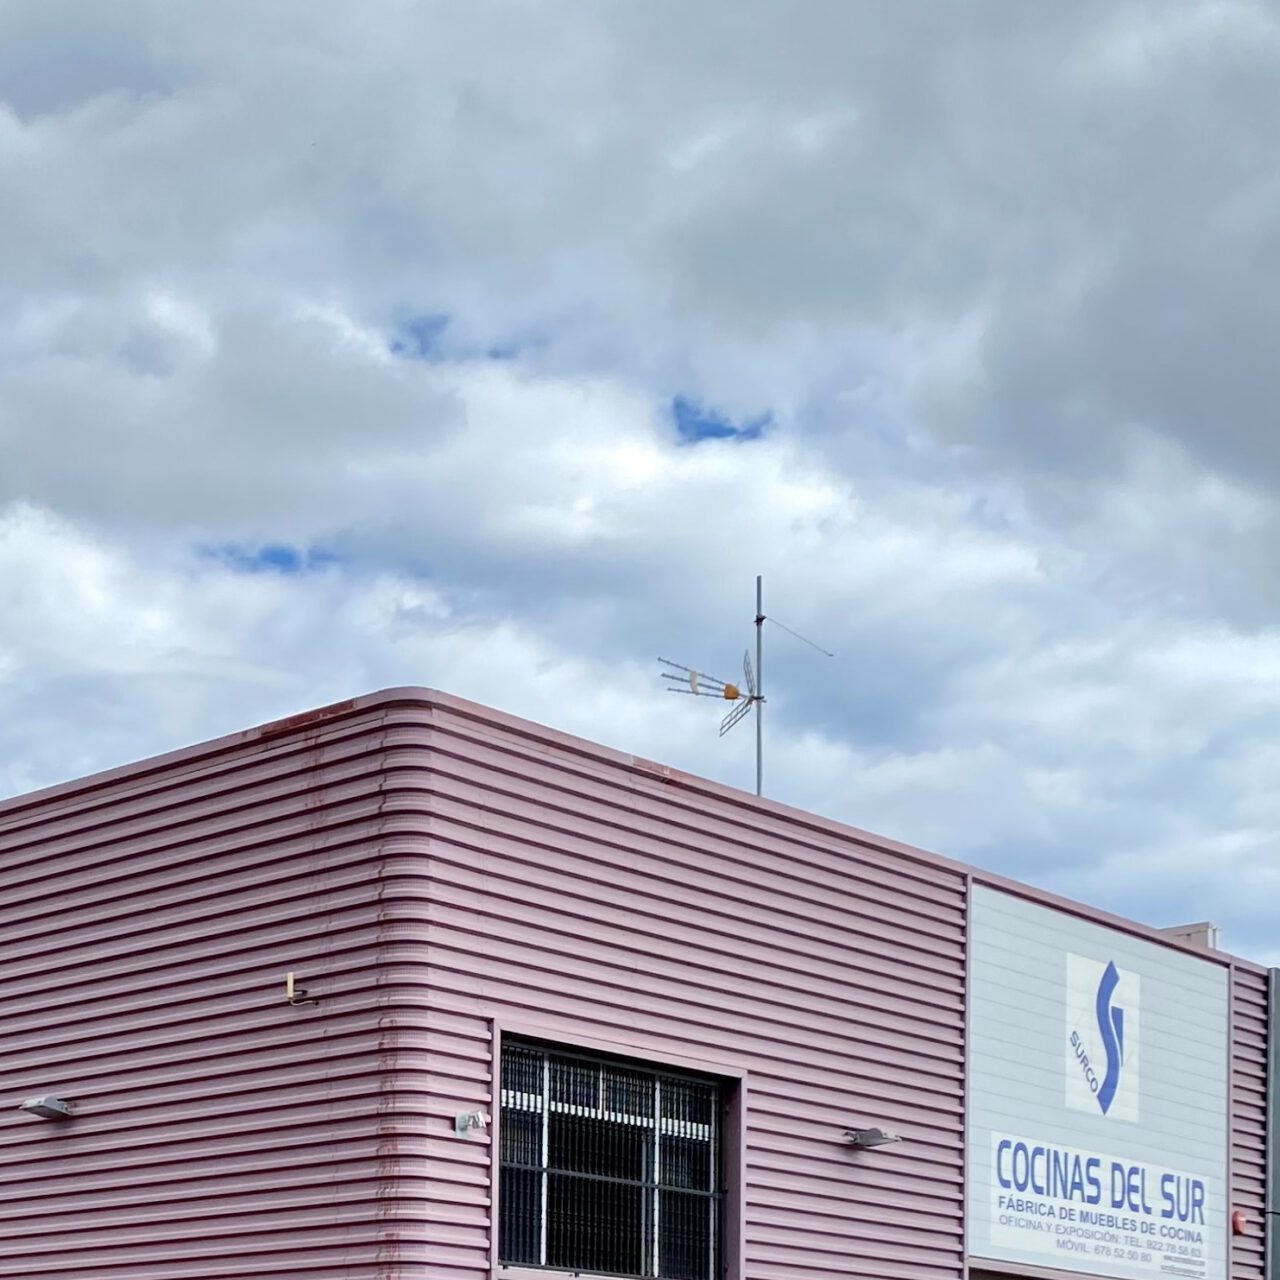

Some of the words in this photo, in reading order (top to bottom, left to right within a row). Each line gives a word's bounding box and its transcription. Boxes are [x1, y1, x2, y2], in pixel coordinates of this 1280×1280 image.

[1069, 1030, 1099, 1093] SURCO
[997, 1139, 1101, 1206] COCINAS
[1111, 1162, 1152, 1215] DEL
[1161, 1174, 1205, 1225] SUR
[998, 1194, 1056, 1218] FÁBRICA
[1059, 1206, 1076, 1221] DE
[1080, 1210, 1137, 1232] MUEBLES
[1141, 1221, 1156, 1235] DE
[1160, 1225, 1203, 1244] COCINA
[999, 1214, 1043, 1231] OFICINA
[1045, 1223, 1053, 1232] Y
